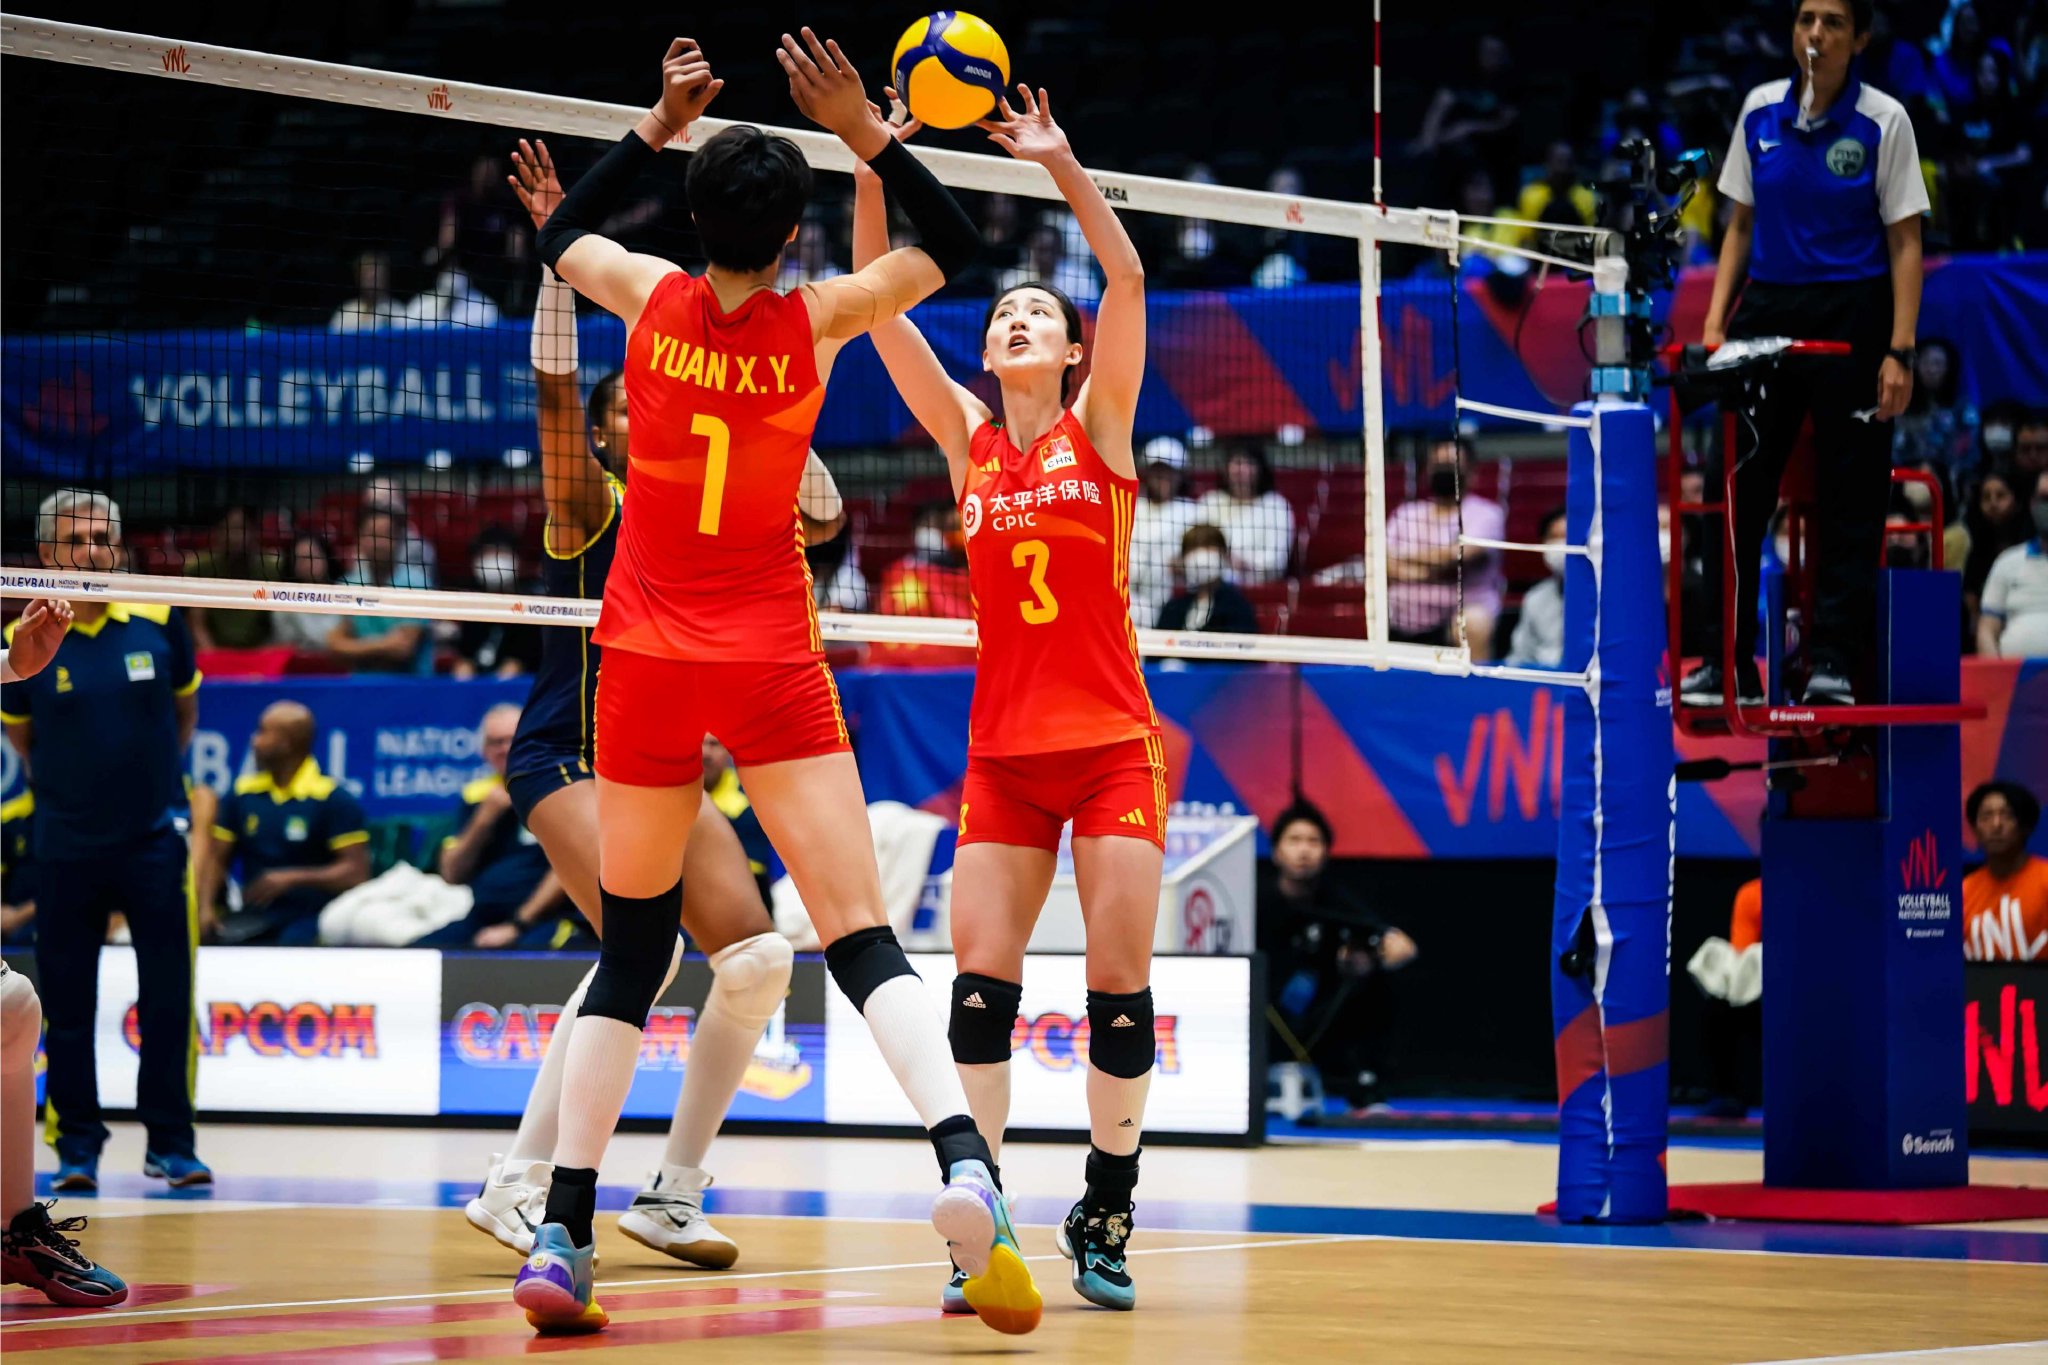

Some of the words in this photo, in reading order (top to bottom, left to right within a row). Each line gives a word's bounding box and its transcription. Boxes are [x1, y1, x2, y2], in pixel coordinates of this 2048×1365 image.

[162, 45, 190, 73] VNL
[427, 84, 453, 111] VNL
[650, 332, 728, 392] YUAN
[735, 356, 768, 394] X.
[769, 355, 796, 393] Y.
[130, 366, 496, 431] VOLLEYBALL
[690, 413, 731, 537] 1
[1046, 455, 1073, 469] CHN
[990, 479, 1102, 514] 太平洋保险
[992, 512, 1037, 531] CPIC
[1011, 539, 1059, 625] 3
[272, 590, 333, 603] VOLLEYBALL
[528, 604, 584, 617] VOLLEYBALL
[1901, 827, 1947, 892] VNL
[1898, 893, 1951, 909] VOLLEYBALL
[963, 1000, 987, 1009] adidas
